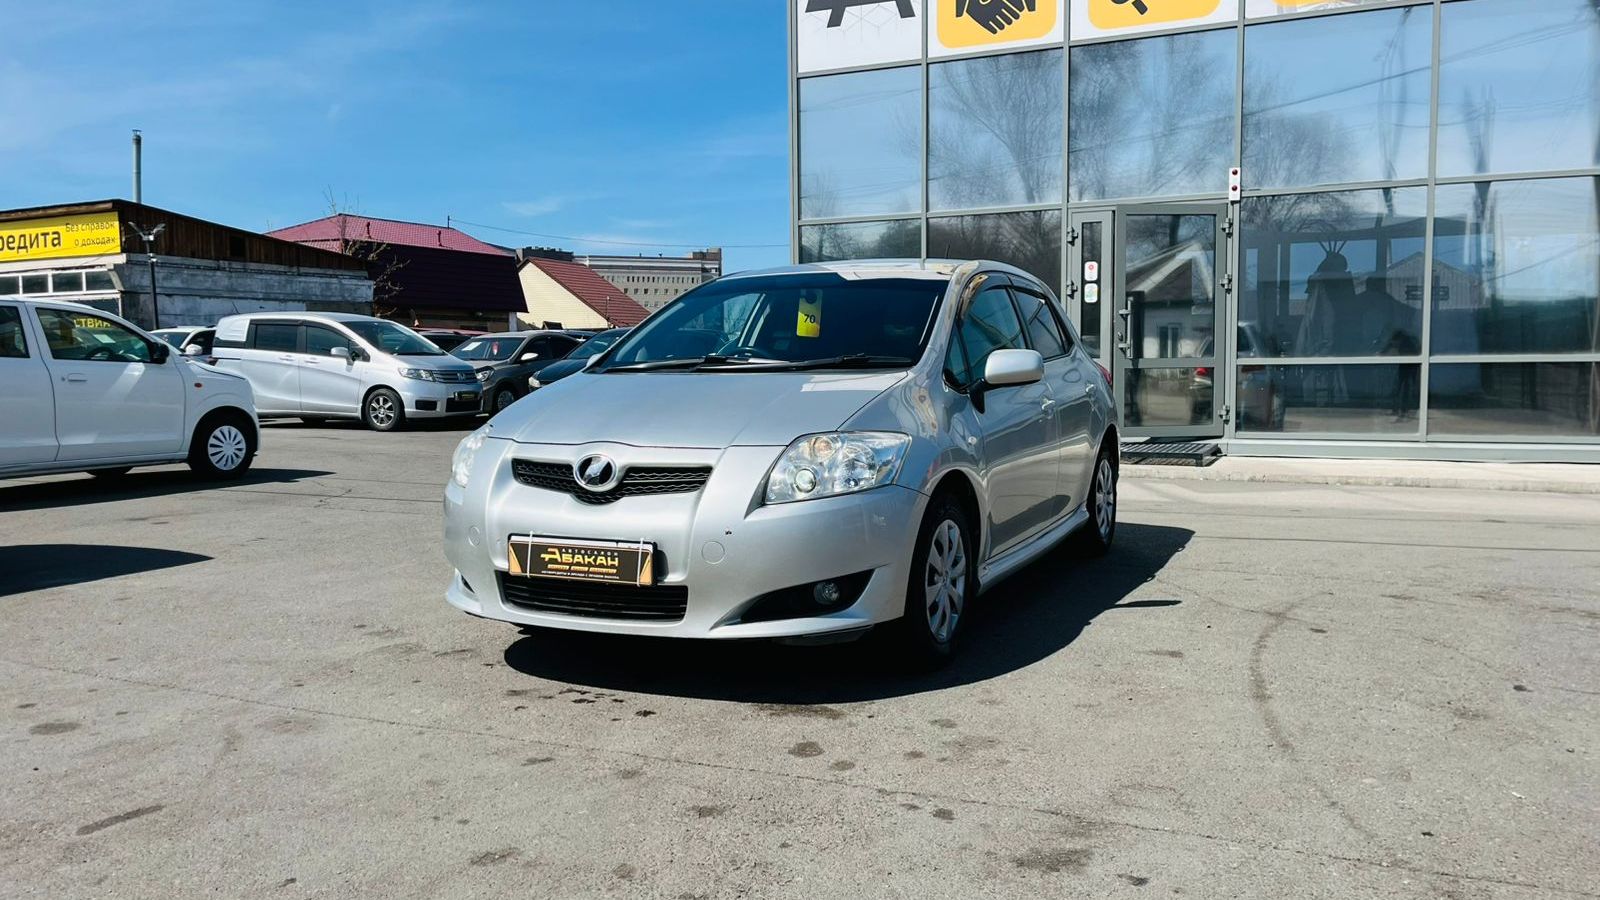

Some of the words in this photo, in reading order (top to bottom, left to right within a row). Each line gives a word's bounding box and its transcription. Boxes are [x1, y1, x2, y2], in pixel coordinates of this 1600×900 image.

[65, 223, 79, 232] Без
[81, 221, 115, 233] справок
[81, 236, 116, 247] доходах
[804, 314, 816, 323] 70
